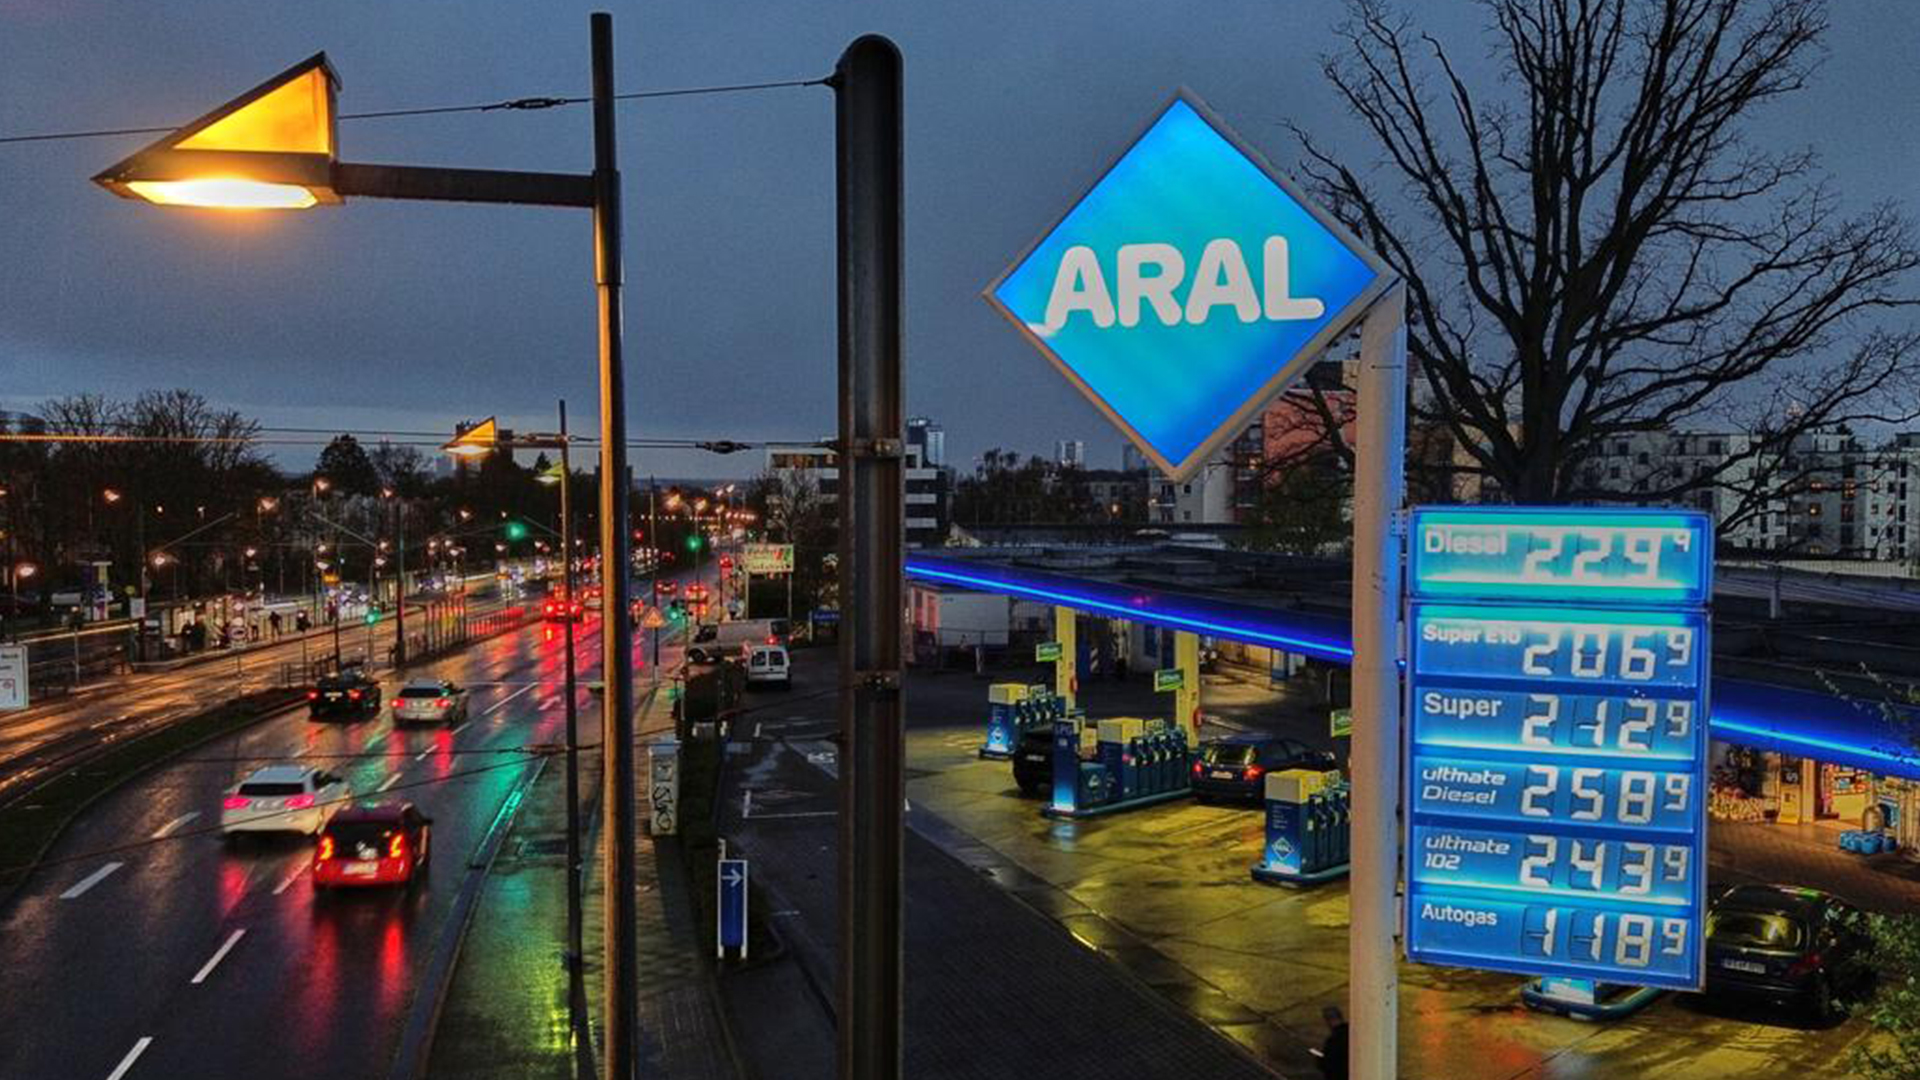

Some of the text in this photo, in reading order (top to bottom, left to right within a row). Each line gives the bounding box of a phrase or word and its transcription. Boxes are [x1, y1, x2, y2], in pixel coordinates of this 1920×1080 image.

[1045, 236, 1325, 328] ARAL
[1425, 530, 1507, 553] Diesel
[1423, 624, 1480, 645] Super
[1423, 693, 1502, 719] Super
[1422, 767, 1506, 786] ultimate
[1422, 785, 1497, 805] Diesel
[1425, 835, 1511, 855] ultimate
[1425, 853, 1461, 871] 102
[1421, 903, 1498, 926] Autogas
